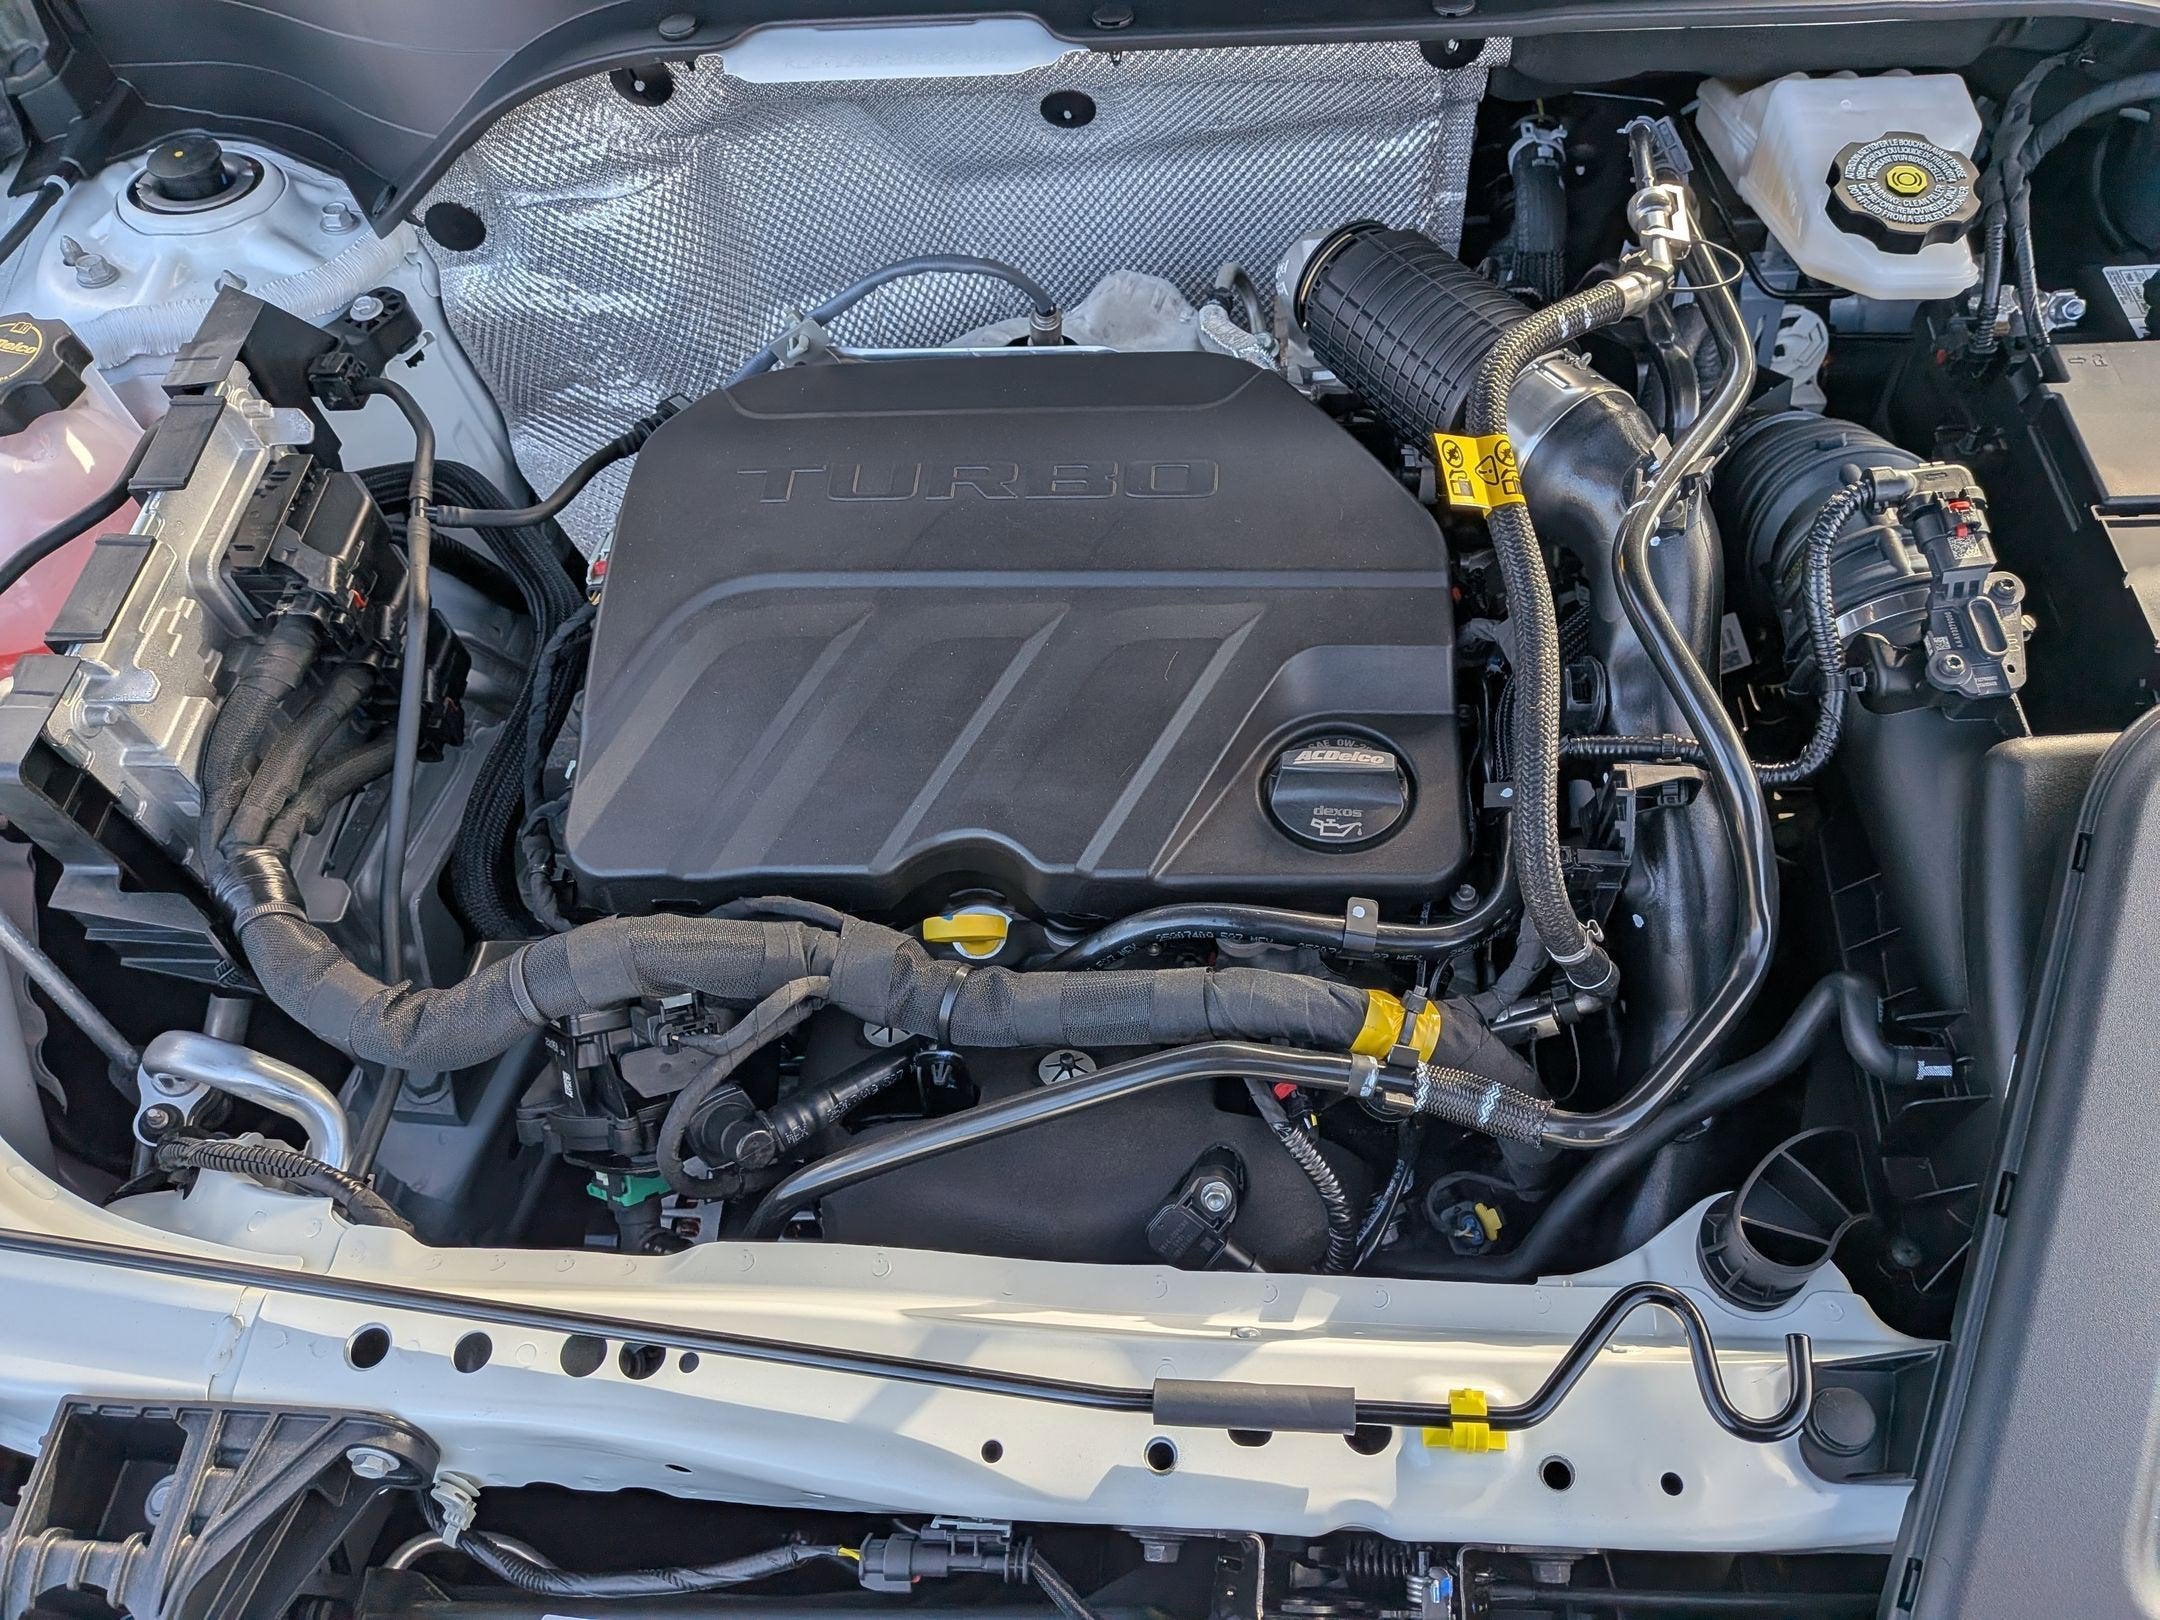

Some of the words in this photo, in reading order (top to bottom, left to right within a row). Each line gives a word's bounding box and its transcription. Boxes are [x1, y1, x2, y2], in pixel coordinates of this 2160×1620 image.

[1897, 147, 1923, 155] LIQUIDE
[1922, 151, 1933, 159] DE
[1899, 139, 1932, 150] BOUCHON
[1930, 147, 1952, 160] AVANT
[1908, 155, 1928, 165] BIDON
[1859, 183, 1872, 194] CAP
[1867, 194, 1896, 211] BEFORE
[1903, 198, 1930, 206] CLEAN
[1927, 184, 1945, 201] FILLER
[1860, 199, 1882, 213] FLUID
[1882, 210, 1906, 221] FROM
[1914, 211, 1944, 222] SEALED
[1942, 186, 1969, 215] CONTAINER
[736, 461, 1219, 503] TURBO
[1308, 739, 1330, 750] SAE
[1295, 750, 1385, 764] ACDelco
[1313, 805, 1363, 817] dexos
